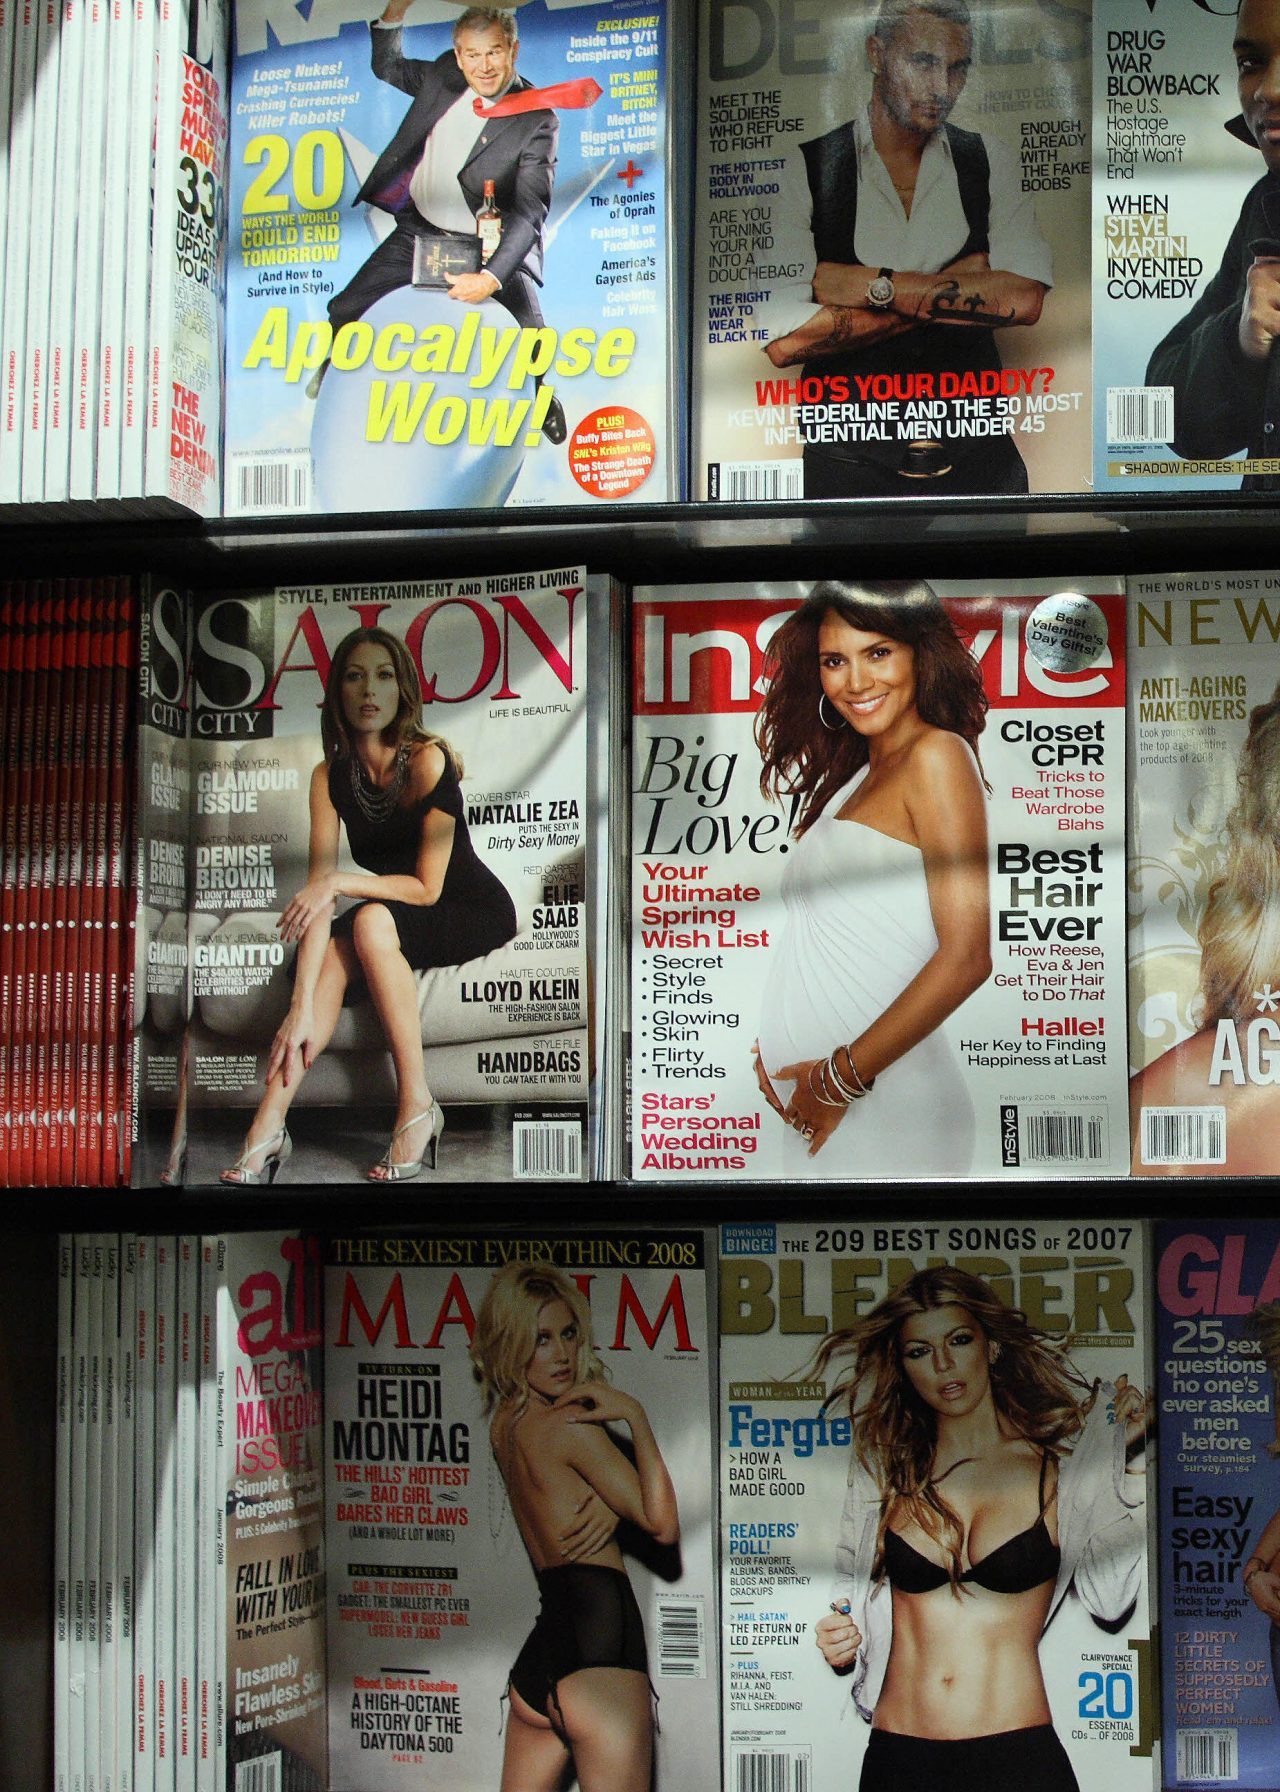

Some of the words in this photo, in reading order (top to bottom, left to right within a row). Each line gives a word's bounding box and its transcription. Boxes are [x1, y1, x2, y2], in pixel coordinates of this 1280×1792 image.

[1107, 30, 1166, 51] DRUG
[1107, 53, 1152, 74] WAR
[1107, 74, 1220, 97] BLOWBACK
[710, 94, 747, 108] MEET
[752, 91, 782, 104] THE
[710, 106, 780, 123] SOLDIERS
[1021, 120, 1081, 135] ENOUGH
[242, 128, 345, 215] 20
[242, 229, 300, 248] COULD
[303, 225, 340, 244] END
[242, 245, 340, 268] TOMORROW
[601, 256, 656, 272] America's
[258, 271, 284, 284] (And
[287, 270, 307, 282] How
[310, 269, 323, 280] to
[242, 307, 636, 390] Apocalypse
[755, 375, 848, 407] WHO'S
[856, 372, 934, 401] YOUR
[940, 367, 1055, 398] DADDY?
[364, 380, 554, 448] Wow!
[596, 416, 625, 429] PLUS!
[764, 422, 892, 446] INFLUENTIAL
[897, 420, 941, 440] MEN
[947, 417, 1015, 439] UNDER
[1020, 415, 1045, 433] 45
[1125, 461, 1180, 475] SHADOW
[1183, 461, 1234, 473] FORCES:
[1236, 461, 1259, 473] THE
[279, 588, 328, 605] STYLE,
[332, 582, 454, 603] ENTERTAINMENT
[458, 581, 482, 596] AND
[486, 576, 541, 594] HIGHER
[542, 570, 579, 591] LIVING
[1140, 675, 1247, 700] ANTI-AGING
[1139, 700, 1248, 723] MAKEOVERS
[1000, 720, 1105, 744] Closet
[1031, 744, 1104, 767] CPR
[197, 769, 299, 793] GLAMOUR
[634, 735, 738, 808] Big
[198, 792, 258, 814] ISSUE
[467, 802, 543, 826] NATALIE
[548, 800, 579, 821] ZEA
[634, 792, 798, 856] Love!
[642, 907, 736, 928] Spring
[641, 930, 711, 949] Wish
[718, 929, 769, 948] List
[461, 981, 523, 1003] LLOYD
[529, 979, 580, 1001] KLEIN
[1020, 1017, 1105, 1036] Halle!
[477, 1051, 581, 1074] HANDBAGS
[782, 1239, 809, 1253] THE
[815, 1229, 865, 1253] 209
[873, 1229, 940, 1252] BEST
[948, 1227, 1037, 1251] SONGS
[1043, 1238, 1061, 1250] OF
[1067, 1227, 1133, 1250] 2007
[332, 1239, 387, 1262] THE
[390, 1240, 477, 1264] SEXIEST
[484, 1240, 641, 1264] EVERYTHING
[647, 1242, 696, 1265] 2008
[1172, 1320, 1226, 1354] 25
[1227, 1338, 1262, 1355] sex
[1164, 1357, 1267, 1376] questions
[216, 1371, 225, 1386] The
[216, 1388, 225, 1421] Beauty
[358, 1379, 442, 1419] HEIDI
[216, 1422, 225, 1447] Expert
[333, 1421, 470, 1464] MONTAG
[728, 1405, 851, 1458] Fergie
[1172, 1487, 1254, 1526] Easy
[216, 1508, 225, 1542] January
[729, 1523, 800, 1539] READERS'
[729, 1539, 771, 1555] POLL!
[1171, 1524, 1250, 1558] sexy
[216, 1542, 225, 1565] 2008
[1078, 1672, 1133, 1719] 20
[351, 1712, 410, 1730] HISTORY
[414, 1716, 433, 1732] OF
[437, 1717, 463, 1734] THE
[1089, 1720, 1134, 1731] ESSENTIAL
